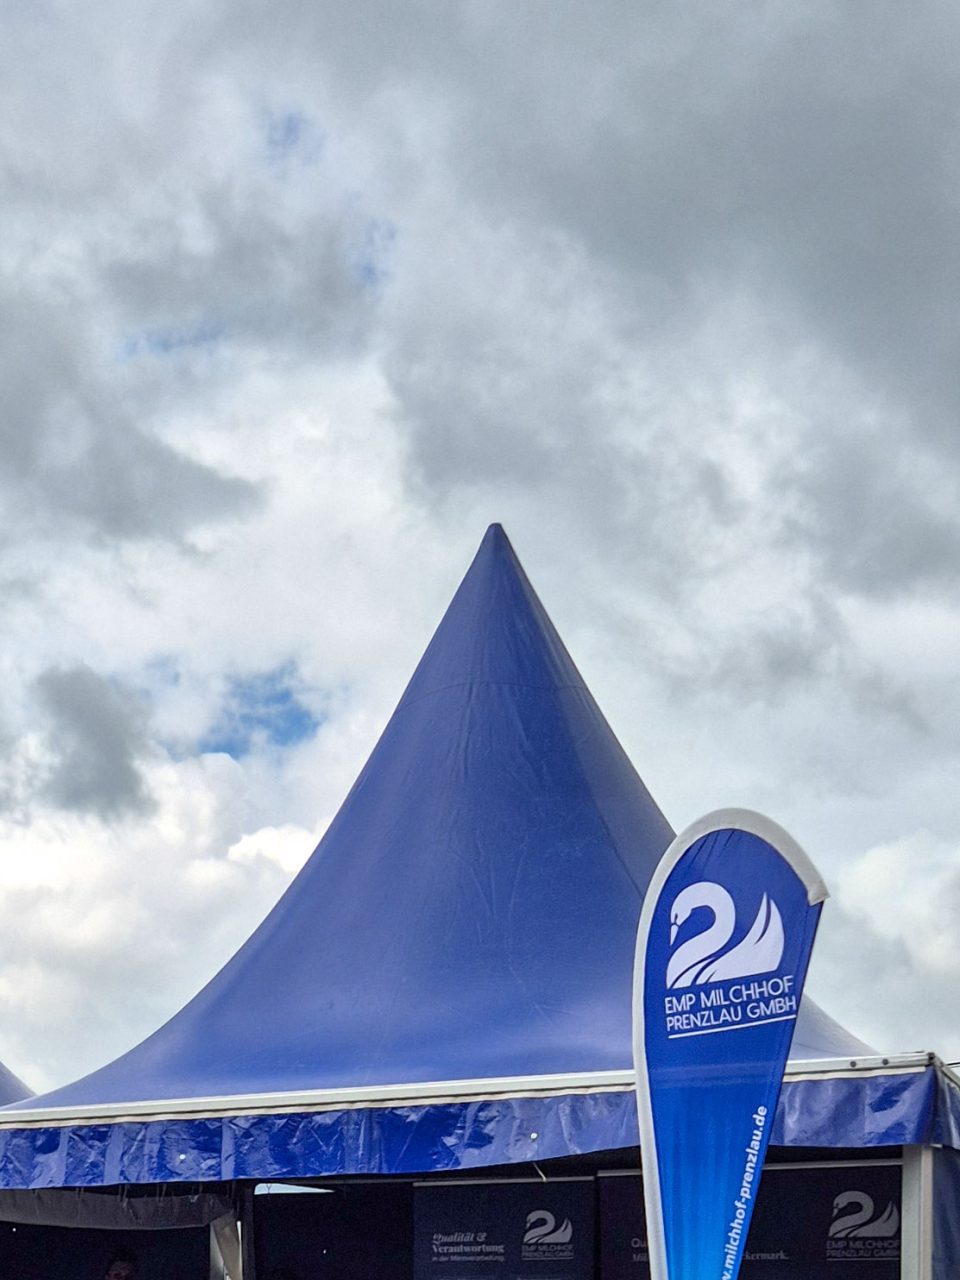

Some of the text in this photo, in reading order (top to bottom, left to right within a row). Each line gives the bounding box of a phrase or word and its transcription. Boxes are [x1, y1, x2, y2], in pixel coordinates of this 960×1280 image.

[665, 975, 794, 1015] EMP MILCHHOF
[666, 995, 797, 1031] PRENZLAU GMBH
[432, 1244, 505, 1254] Verantwortung
